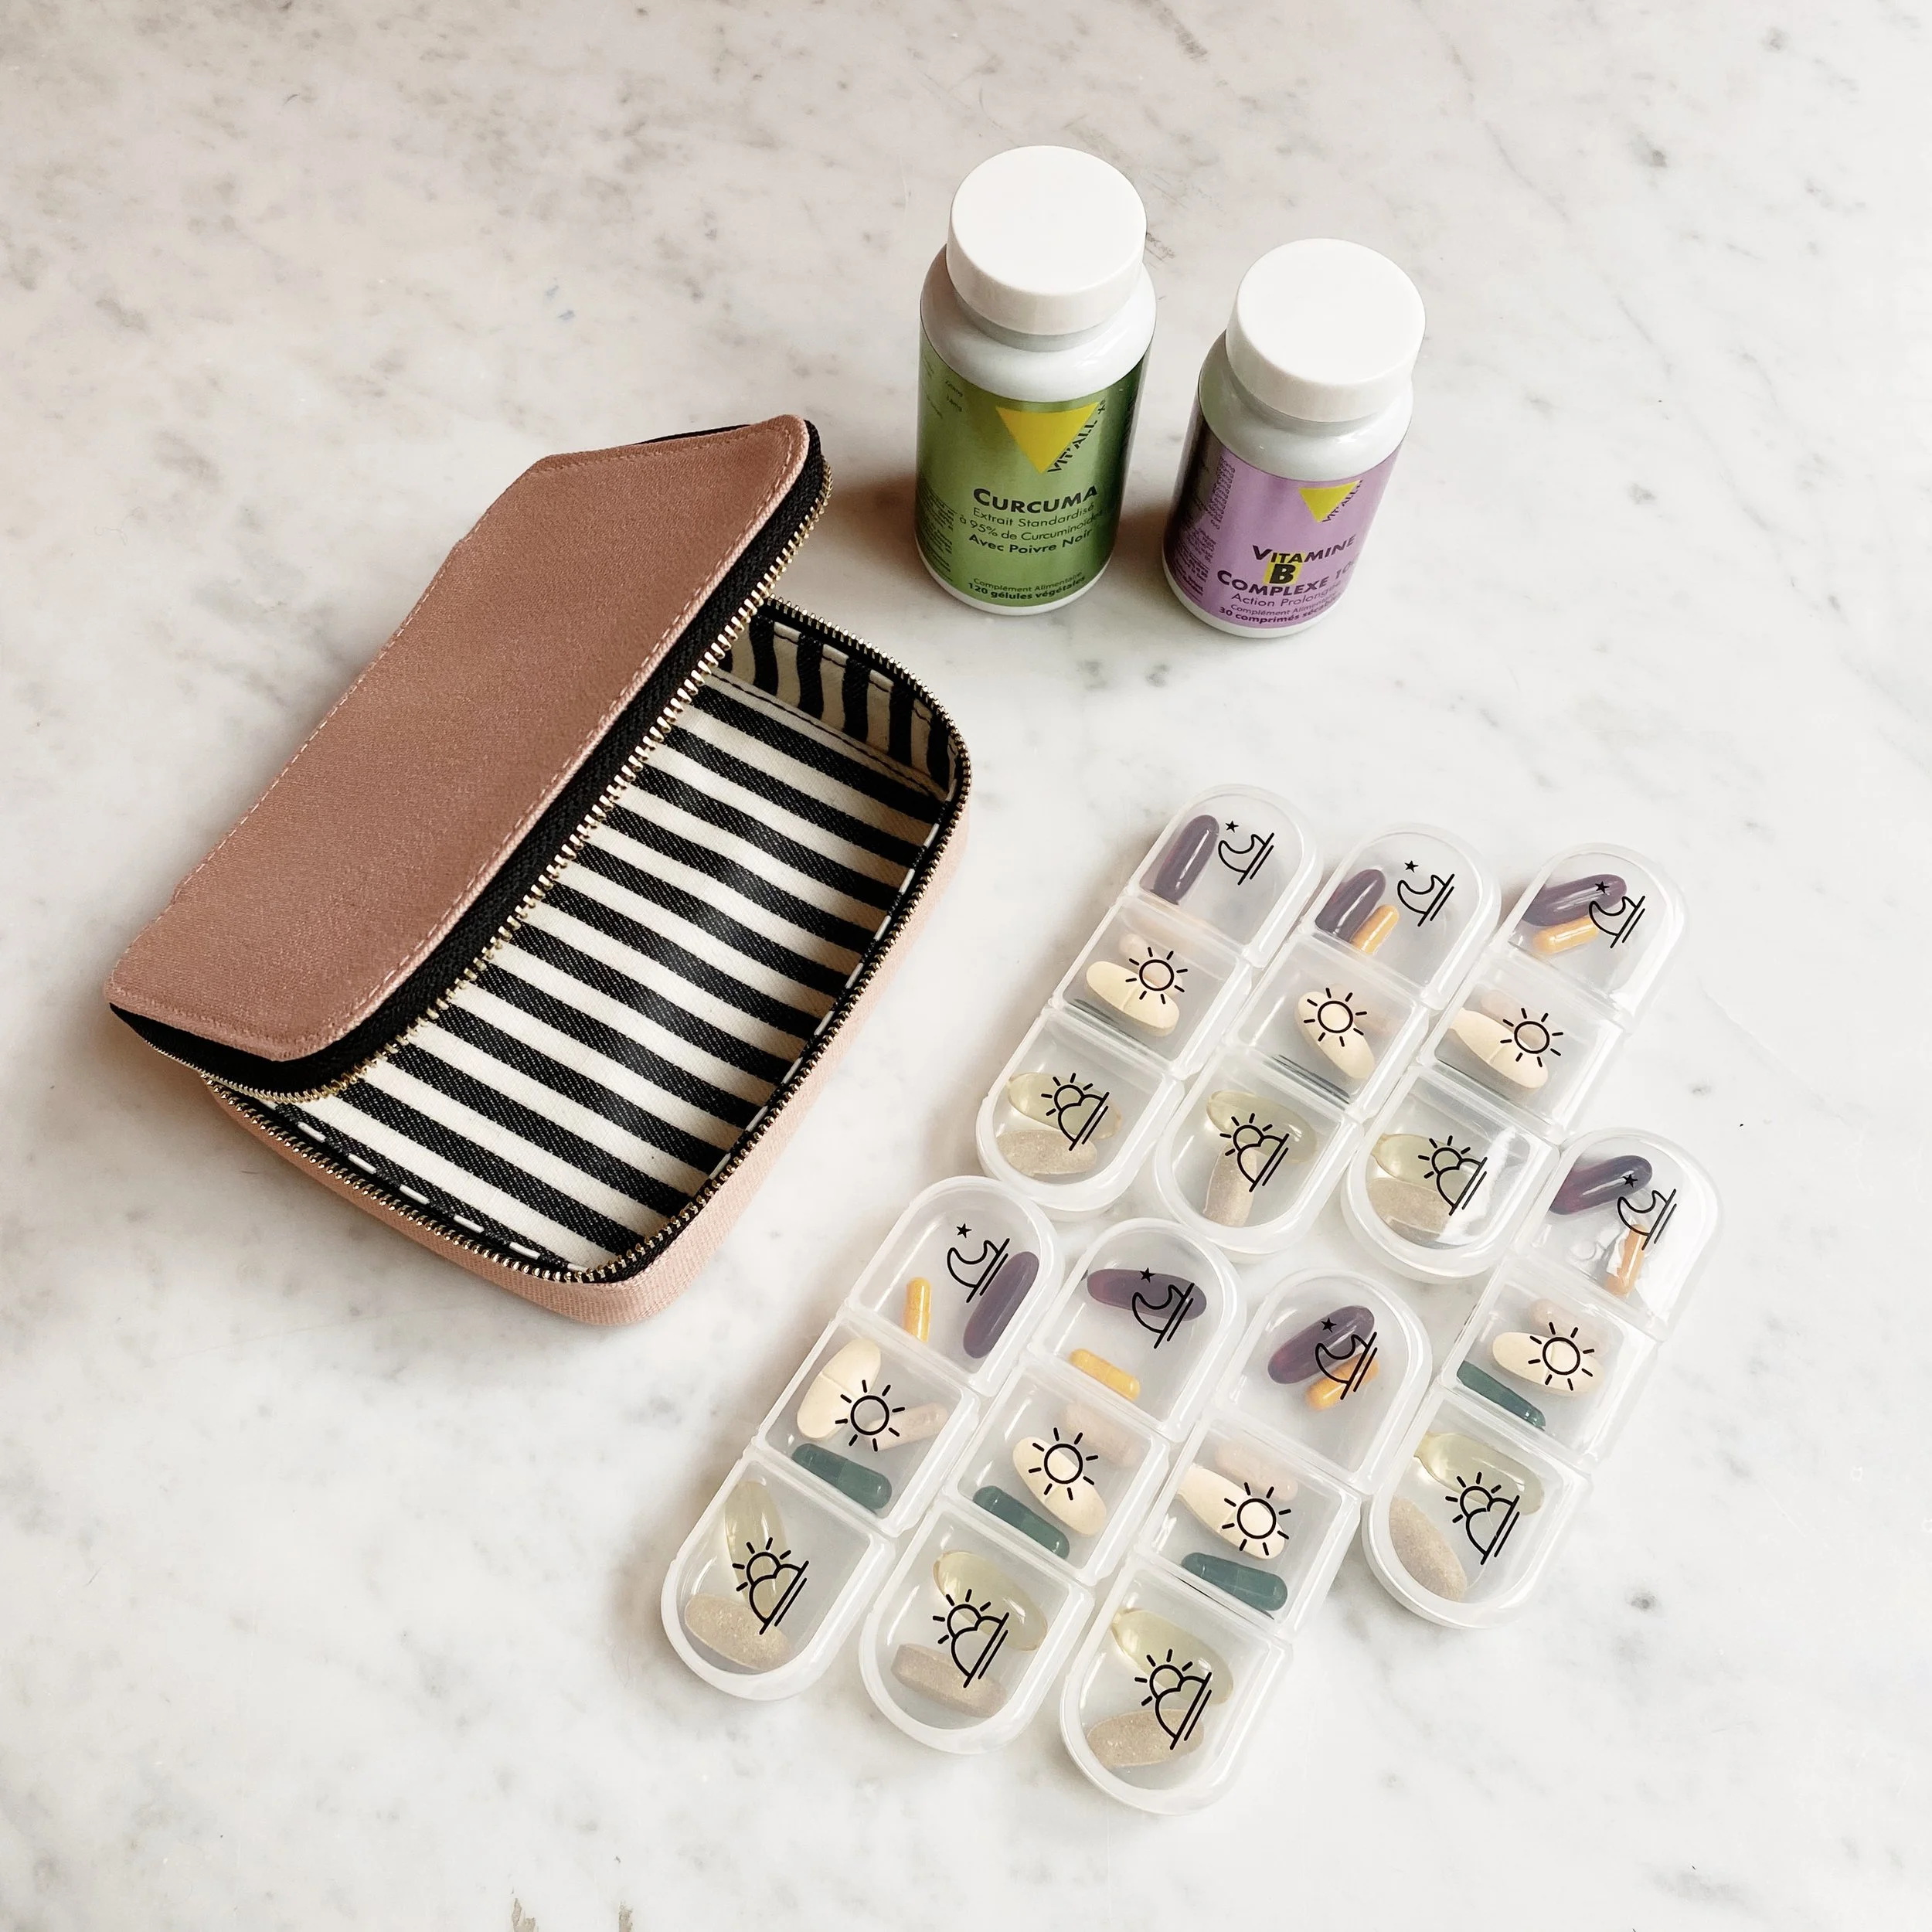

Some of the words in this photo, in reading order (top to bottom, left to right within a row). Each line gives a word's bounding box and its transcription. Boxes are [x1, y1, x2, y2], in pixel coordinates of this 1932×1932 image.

[973, 485, 1098, 514] CURCUMA
[973, 507, 1013, 526] Extrait
[1018, 502, 1095, 528] Standardisé
[959, 514, 967, 524] à
[969, 519, 998, 537] 95%
[1001, 528, 1017, 540] de
[968, 533, 1004, 552] Avec
[1009, 543, 1057, 554] Poivre
[1062, 528, 1094, 548] Noir
[1252, 533, 1357, 564] VITAMINE
[1216, 570, 1330, 597] COMPLEXE
[1269, 563, 1296, 584] B
[968, 582, 988, 594] 120
[990, 589, 1033, 600] gélules
[973, 577, 1032, 594] Complément
[1230, 593, 1275, 607] Action
[1230, 603, 1291, 617] Complément
[1218, 606, 1233, 617] 30
[1235, 613, 1300, 625] comprimés
